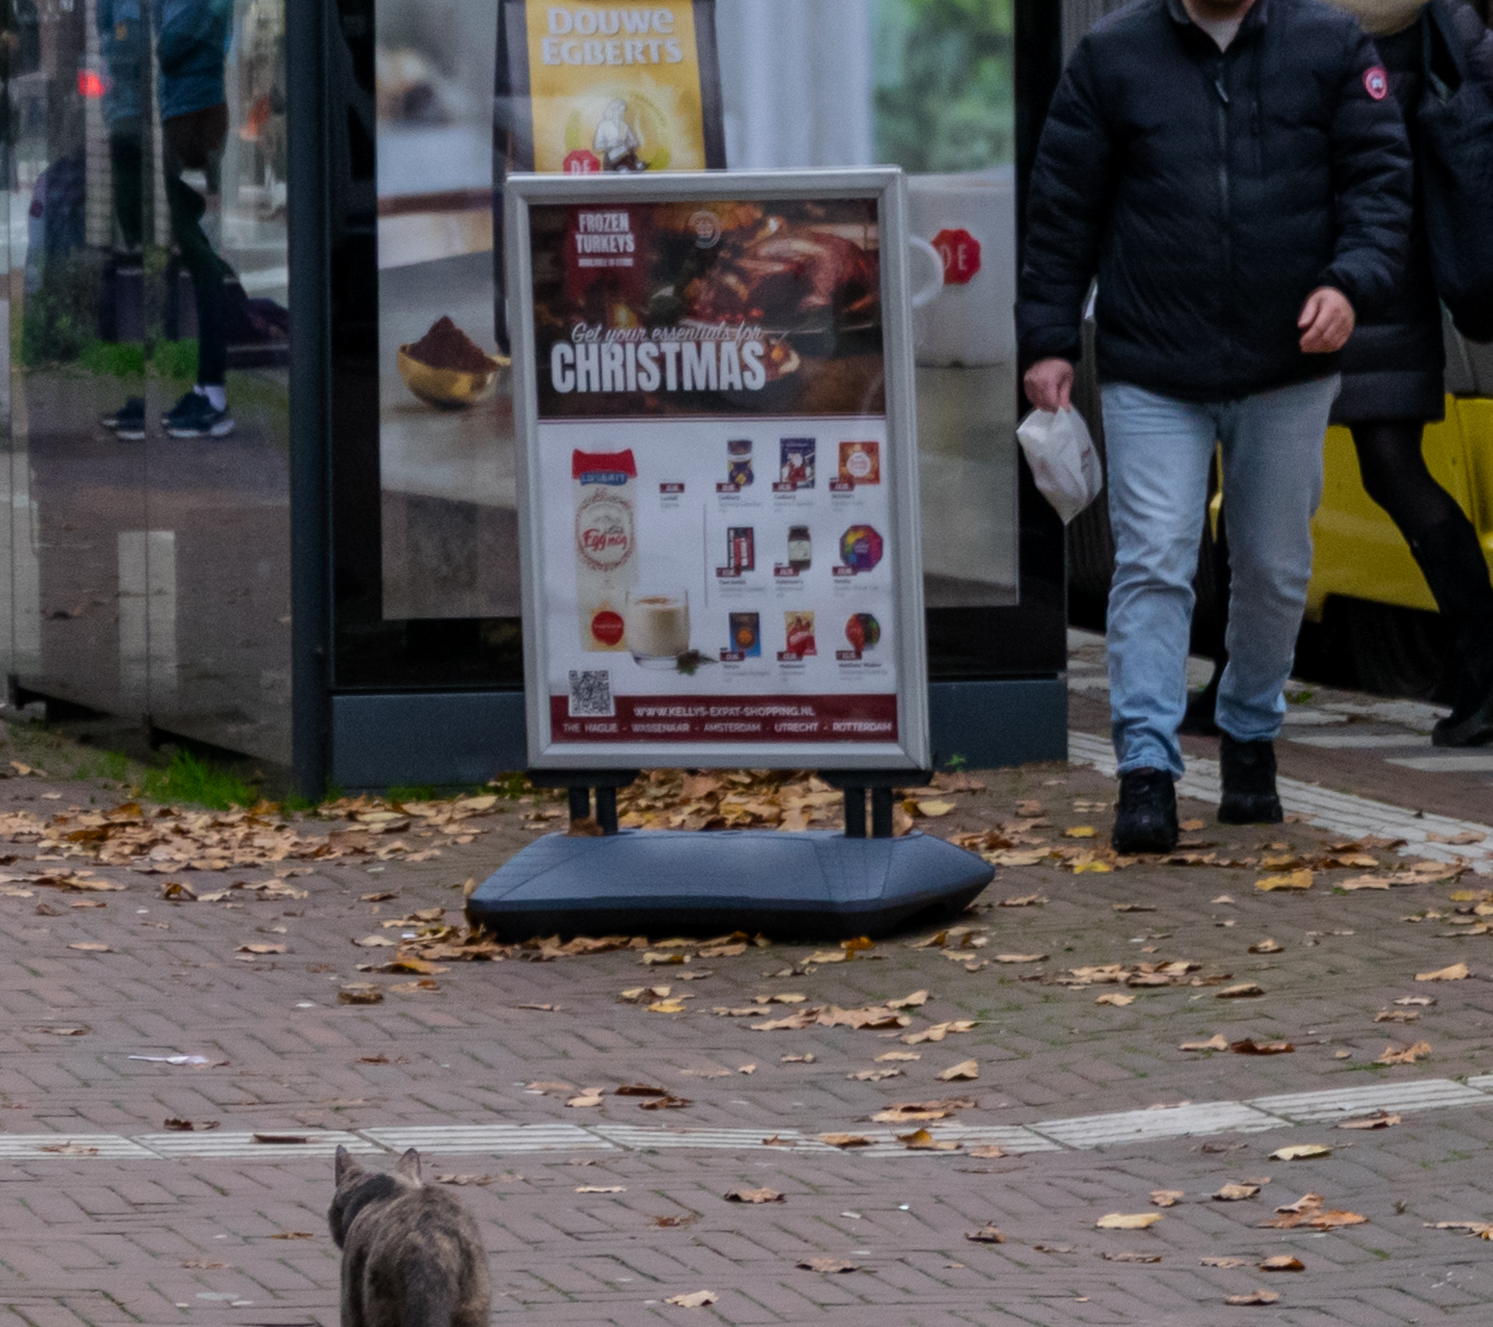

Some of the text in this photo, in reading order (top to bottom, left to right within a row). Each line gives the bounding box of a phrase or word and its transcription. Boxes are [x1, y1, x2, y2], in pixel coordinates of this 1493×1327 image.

[541, 36, 683, 65] EGBERTS
[578, 212, 630, 233] FROZEN
[575, 233, 635, 254] TURKEYS
[571, 320, 763, 352] Get your essentials for
[550, 340, 766, 394] CHRISTMAS
[584, 723, 618, 733] HAGUE
[703, 722, 761, 733] AMSTERDAM
[774, 722, 819, 733] UTRECHT
[832, 721, 892, 733] ROTTERDAM
